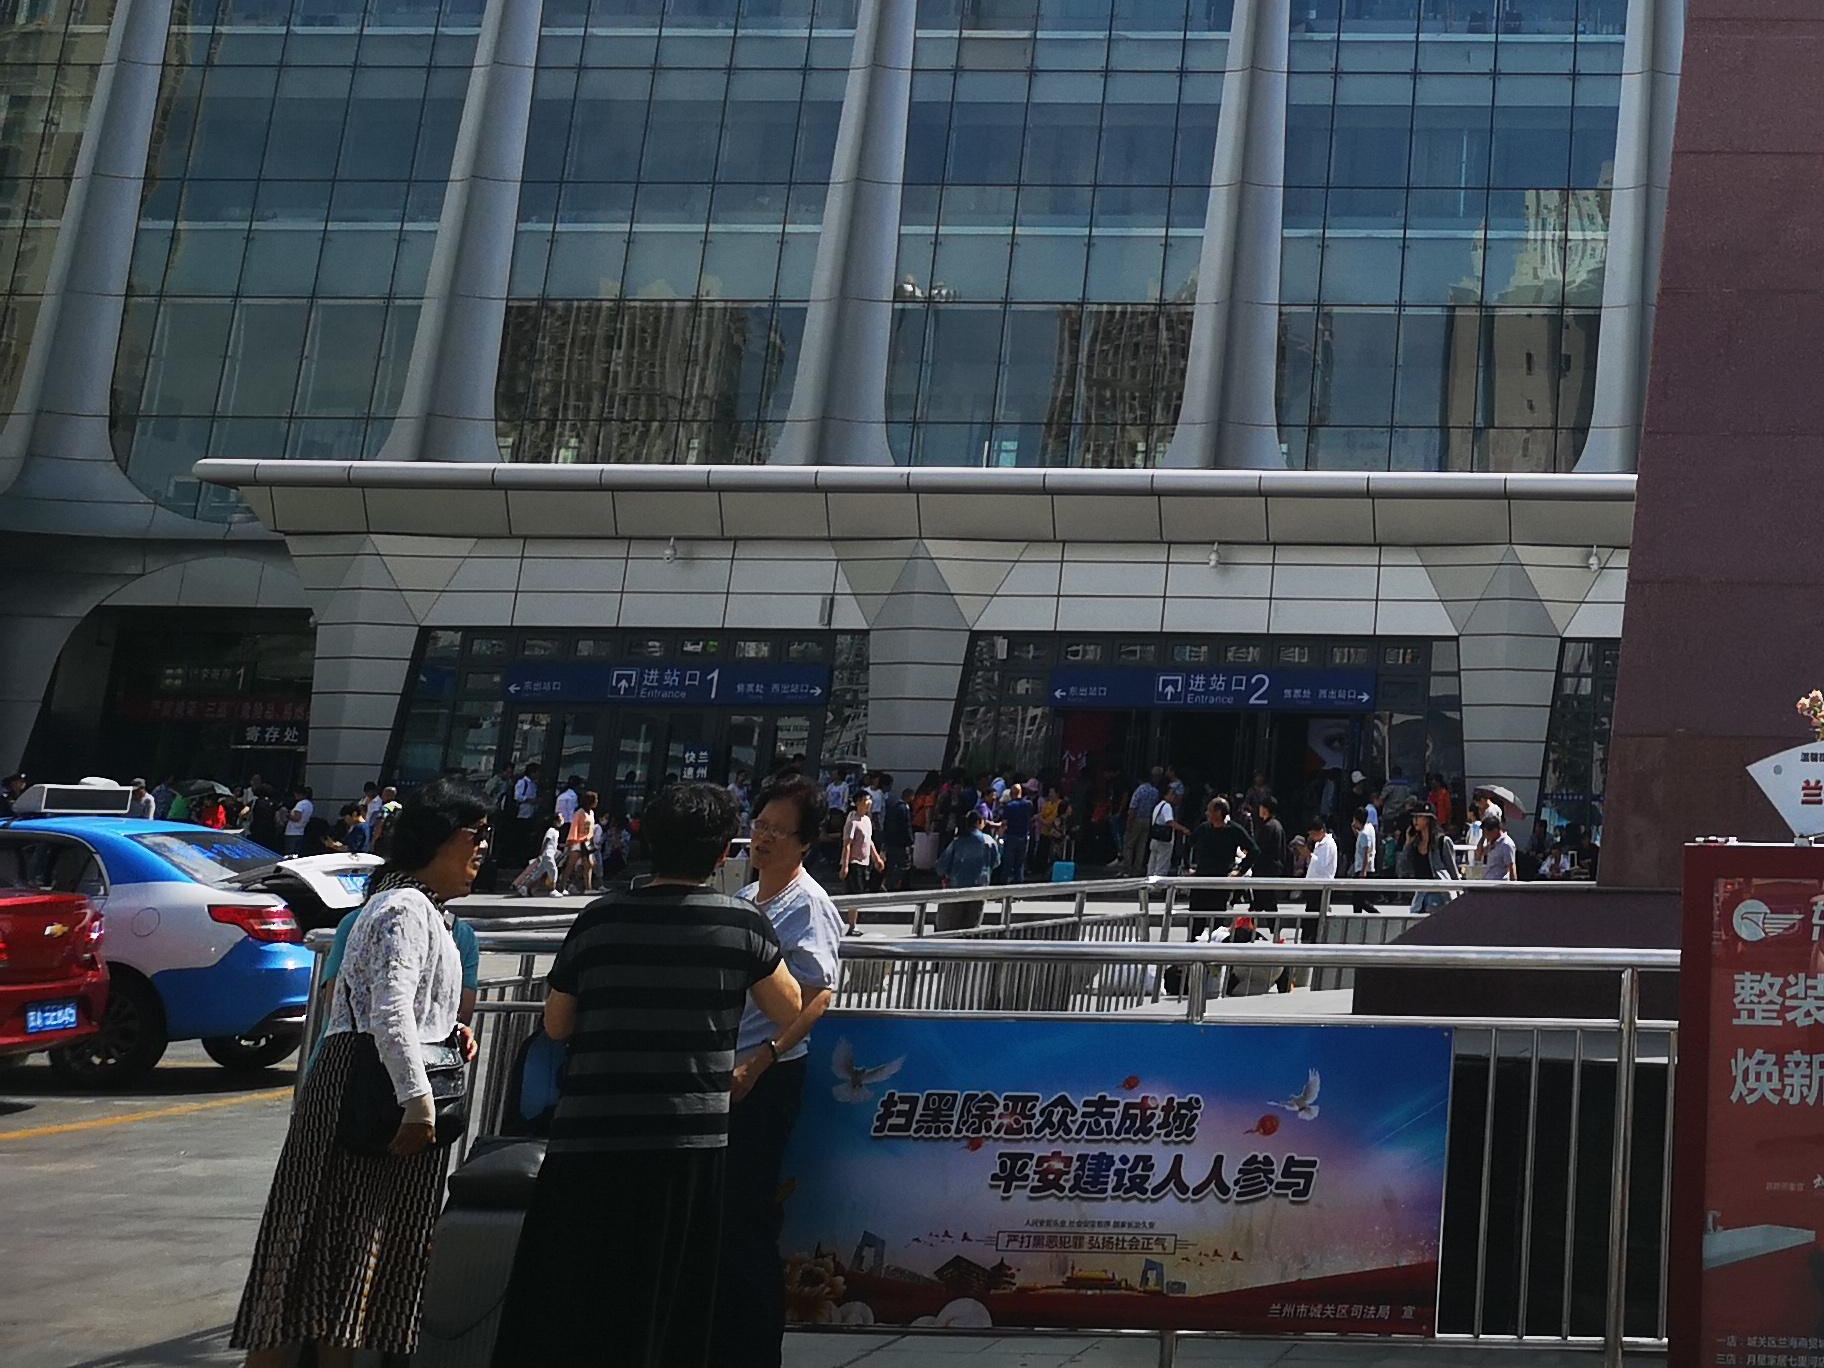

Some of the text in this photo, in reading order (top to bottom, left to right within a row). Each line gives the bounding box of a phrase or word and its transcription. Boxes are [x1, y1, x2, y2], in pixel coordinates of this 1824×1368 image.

[640, 688, 687, 699] Entrance
[642, 669, 720, 700] 进站口 1
[1188, 673, 1269, 704] 进站口 2
[1187, 693, 1235, 704] Entrance
[245, 725, 299, 743] 寄存处
[874, 1091, 1202, 1140] 扫黑除恶众志成城
[989, 1150, 1318, 1199] 平安建设人人参与
[1005, 1234, 1168, 1251] 严打黑恶犯罪 弘扬社会正气
[1267, 1303, 1391, 1320] 兰州市城关区司法局
